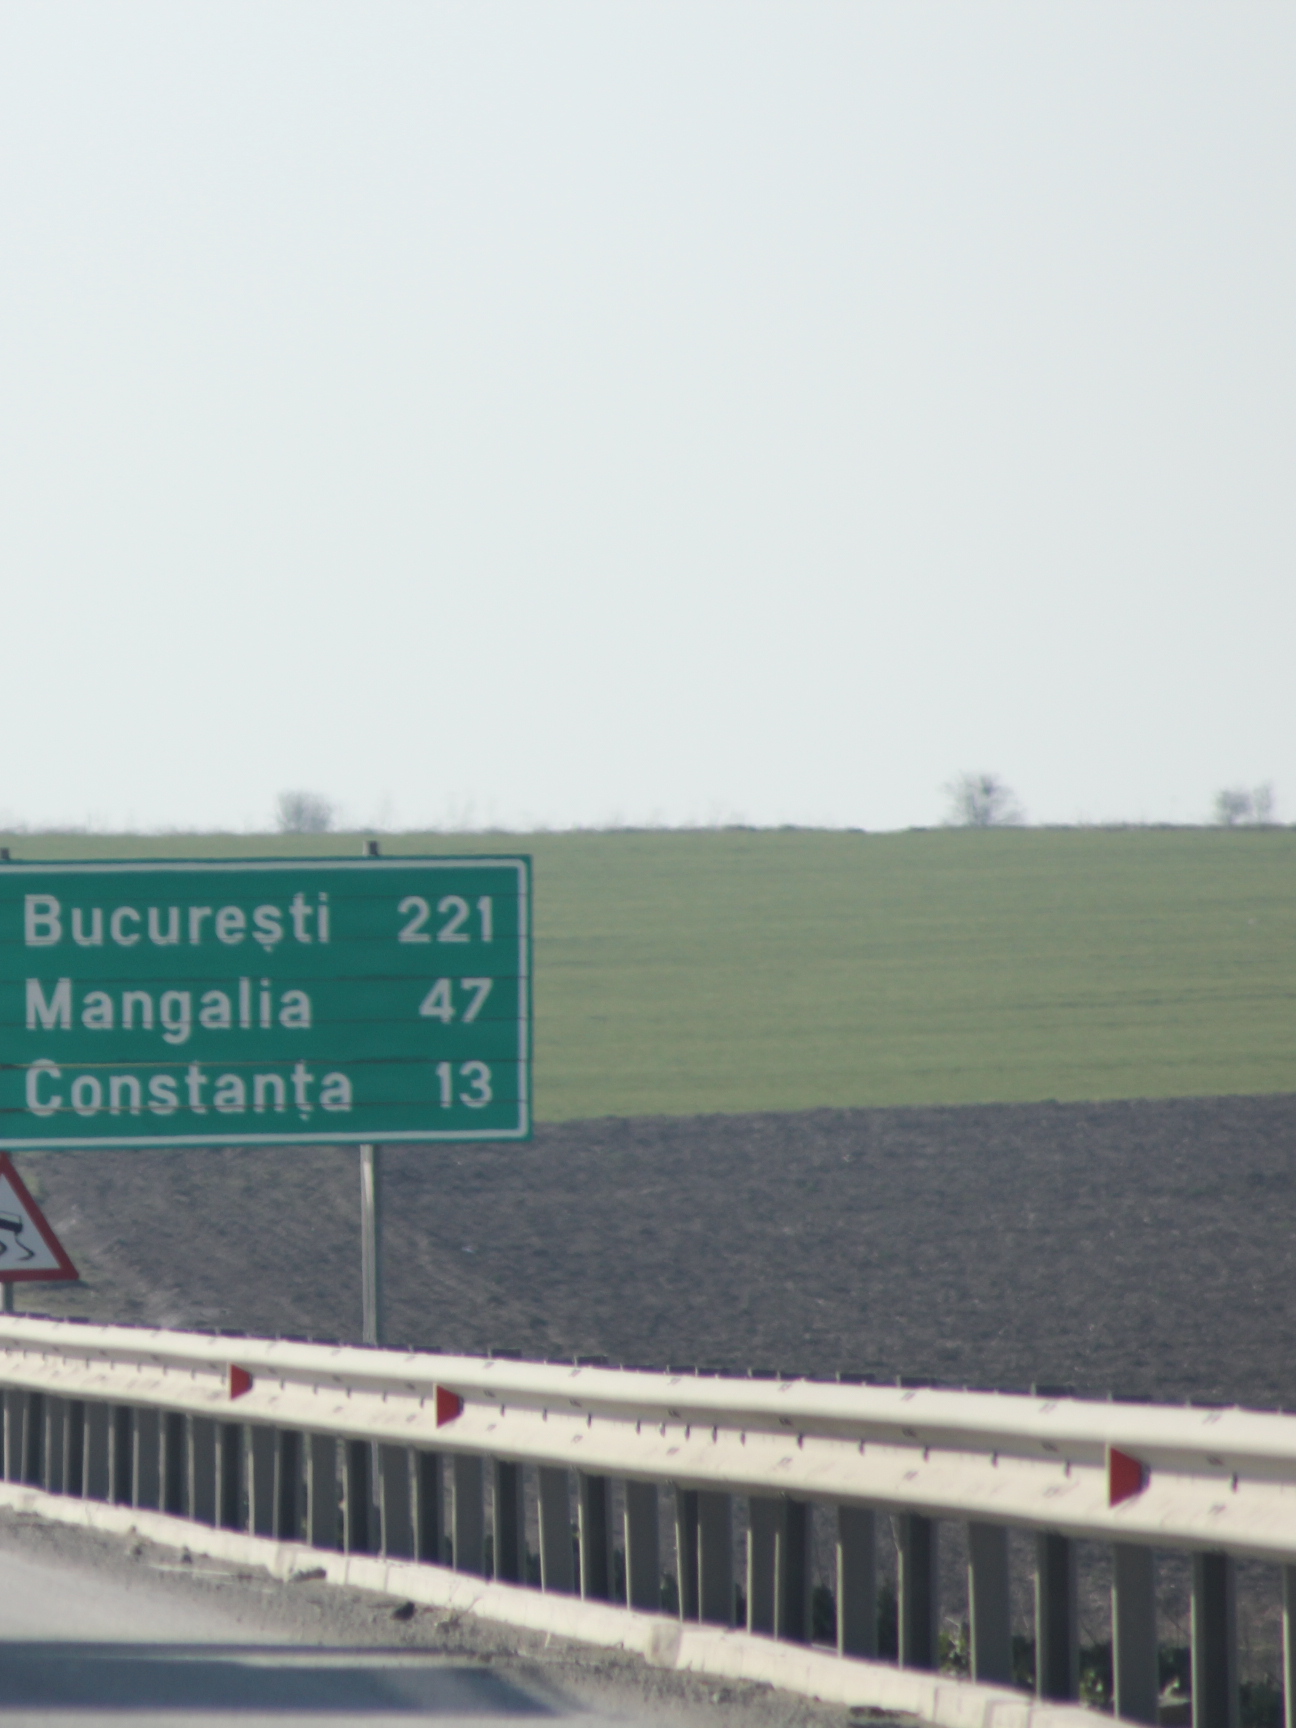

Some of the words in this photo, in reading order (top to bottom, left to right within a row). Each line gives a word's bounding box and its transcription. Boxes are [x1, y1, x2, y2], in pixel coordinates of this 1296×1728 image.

[24, 892, 329, 951] București
[398, 895, 493, 944] 221
[25, 976, 312, 1044] Mangalia
[420, 977, 493, 1024] 47
[25, 1057, 353, 1120] Constanța
[436, 1060, 493, 1108] 13
